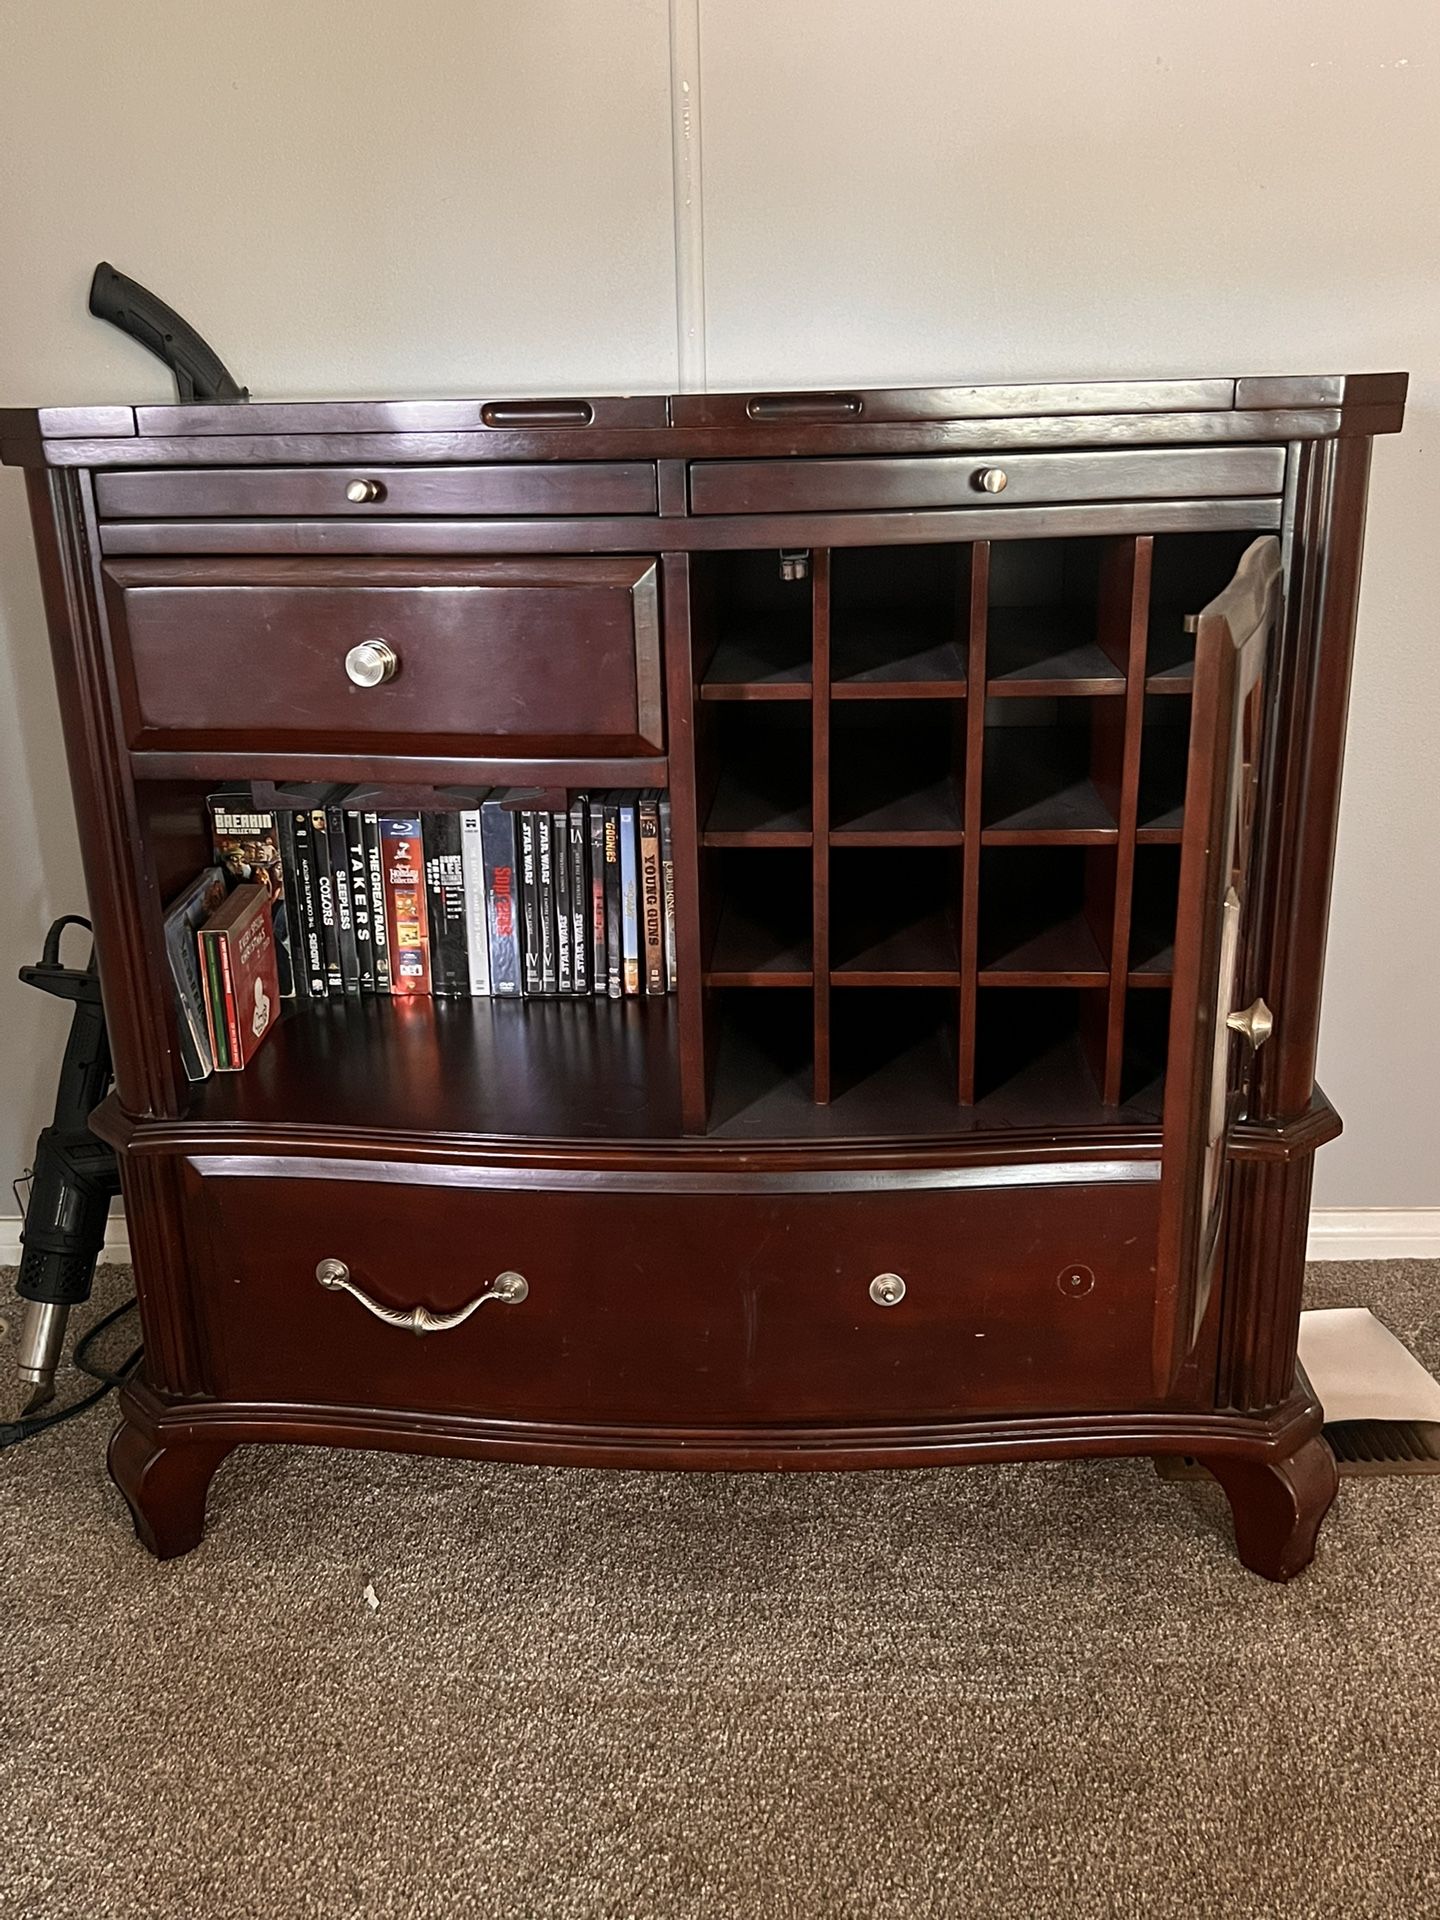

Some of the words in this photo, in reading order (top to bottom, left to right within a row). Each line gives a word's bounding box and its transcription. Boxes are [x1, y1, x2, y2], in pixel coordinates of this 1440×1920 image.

[522, 823, 532, 854] STAR
[539, 821, 549, 853] STAR
[369, 847, 379, 872] THE
[440, 863, 462, 874] LEE
[524, 855, 534, 885] WARS
[541, 854, 550, 884] WARS
[350, 844, 370, 941] TAKERS
[370, 872, 384, 914] GREAT
[644, 854, 658, 906] YOUNG
[319, 876, 334, 926] COLORS
[336, 870, 351, 930] SLEEPLESS
[374, 914, 386, 945] RAID
[559, 914, 569, 944] WARS
[575, 913, 584, 942] WARS
[646, 908, 659, 946] GUNS
[560, 945, 570, 975] STAR
[577, 943, 585, 974] STAR
